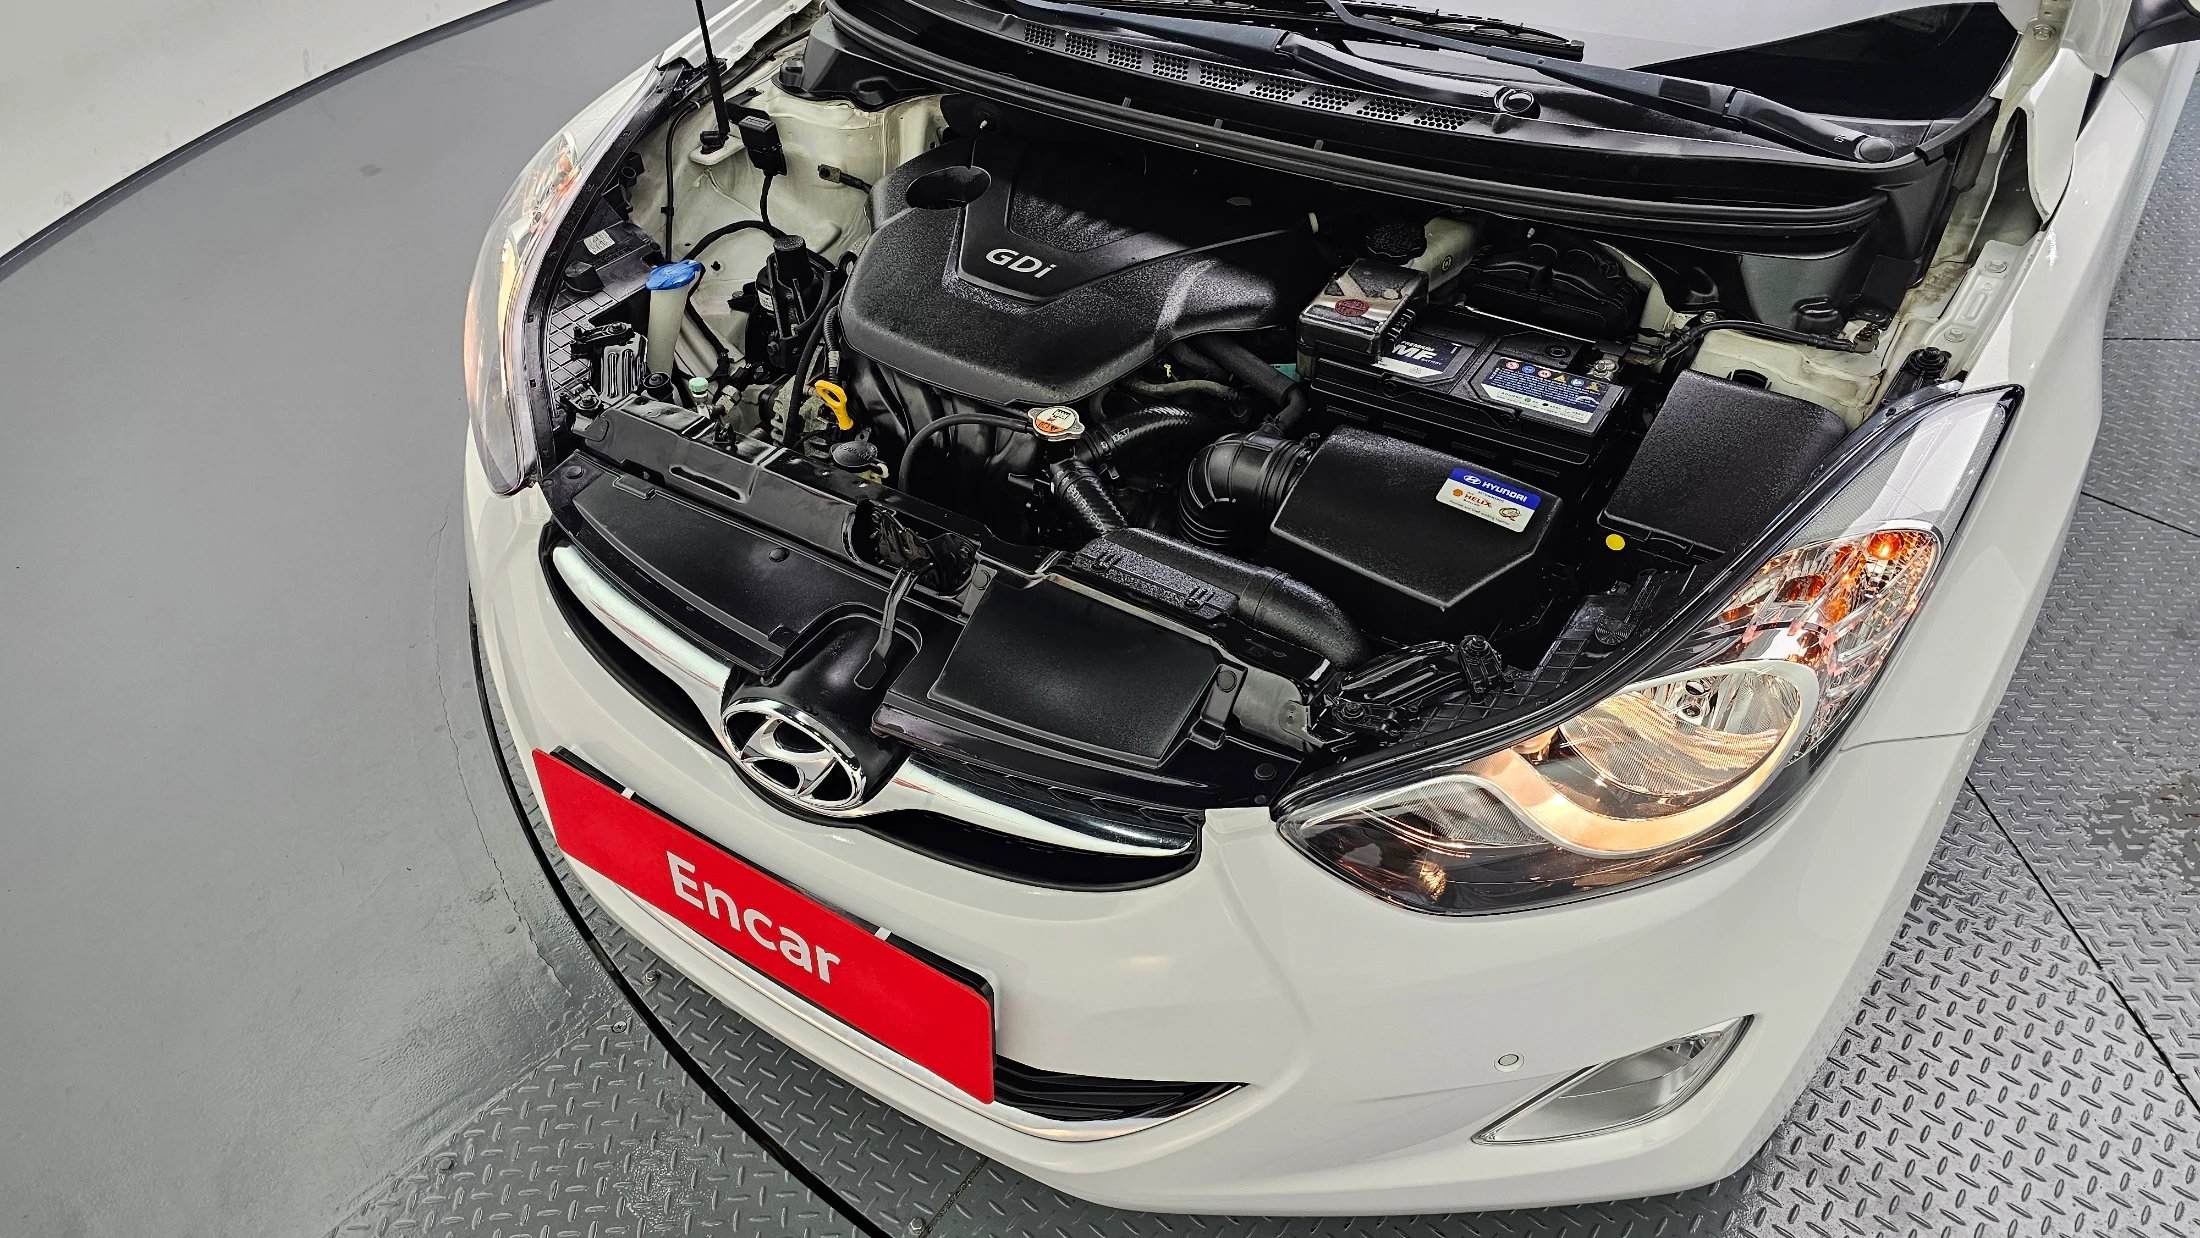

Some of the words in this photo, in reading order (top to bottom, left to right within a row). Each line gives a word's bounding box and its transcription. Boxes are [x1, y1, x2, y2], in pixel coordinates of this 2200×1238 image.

[985, 248, 1058, 279] GDi
[1391, 344, 1438, 360] MF
[1464, 493, 1492, 508] HELIX
[1481, 481, 1528, 503] HYUNDAI
[666, 850, 841, 984] Encar
